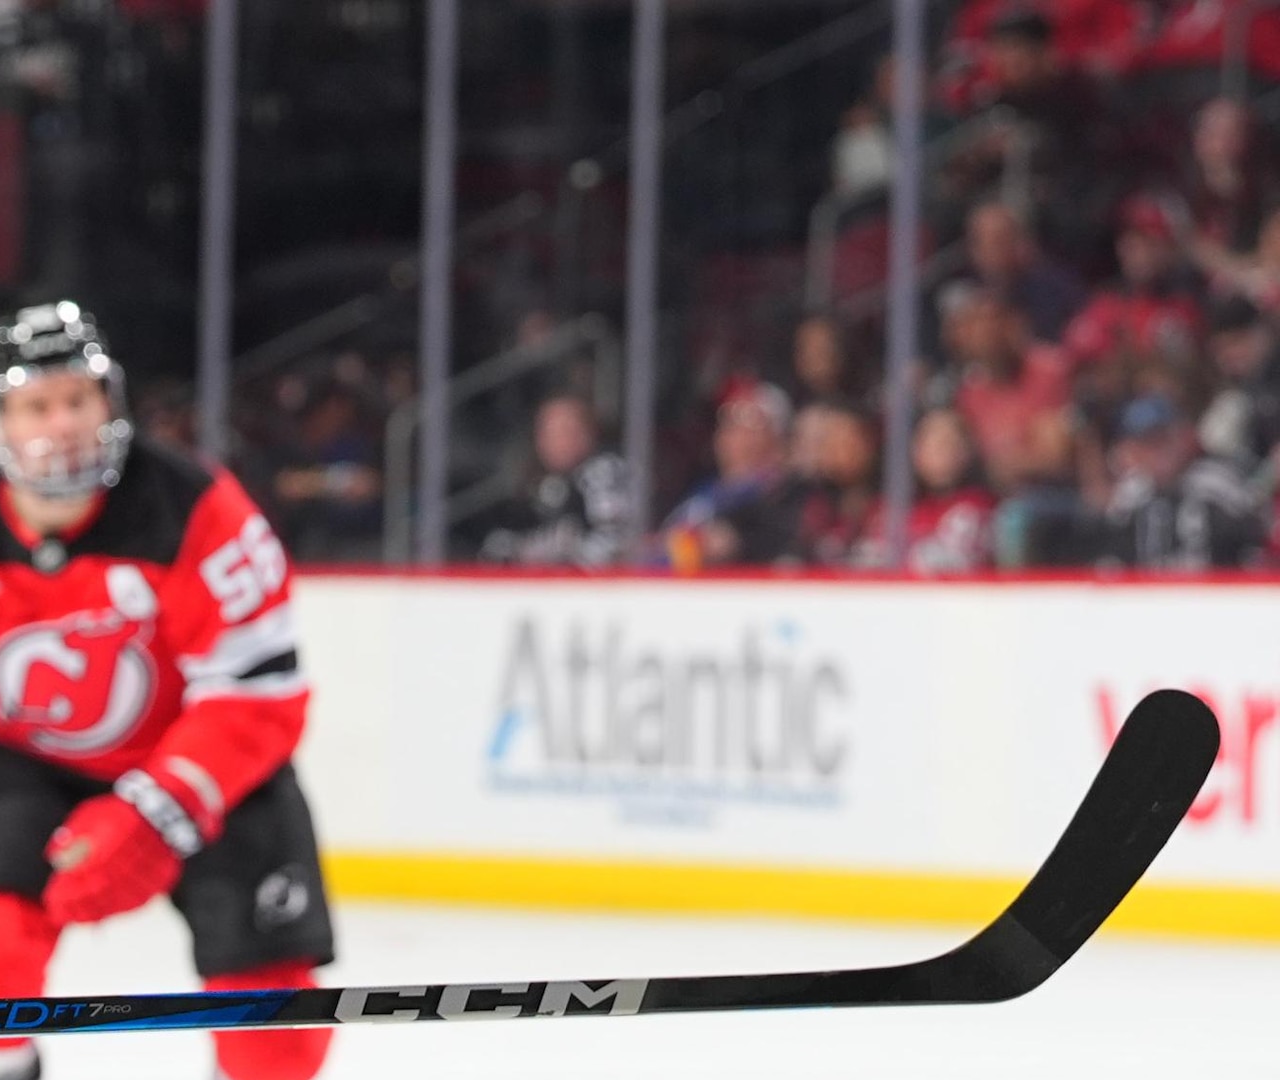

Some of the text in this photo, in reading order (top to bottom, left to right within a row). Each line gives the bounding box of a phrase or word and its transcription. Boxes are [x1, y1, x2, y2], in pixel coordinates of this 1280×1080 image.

[486, 612, 851, 776] Atlantic
[103, 1003, 132, 1014] PRO
[334, 978, 649, 1021] CCM
